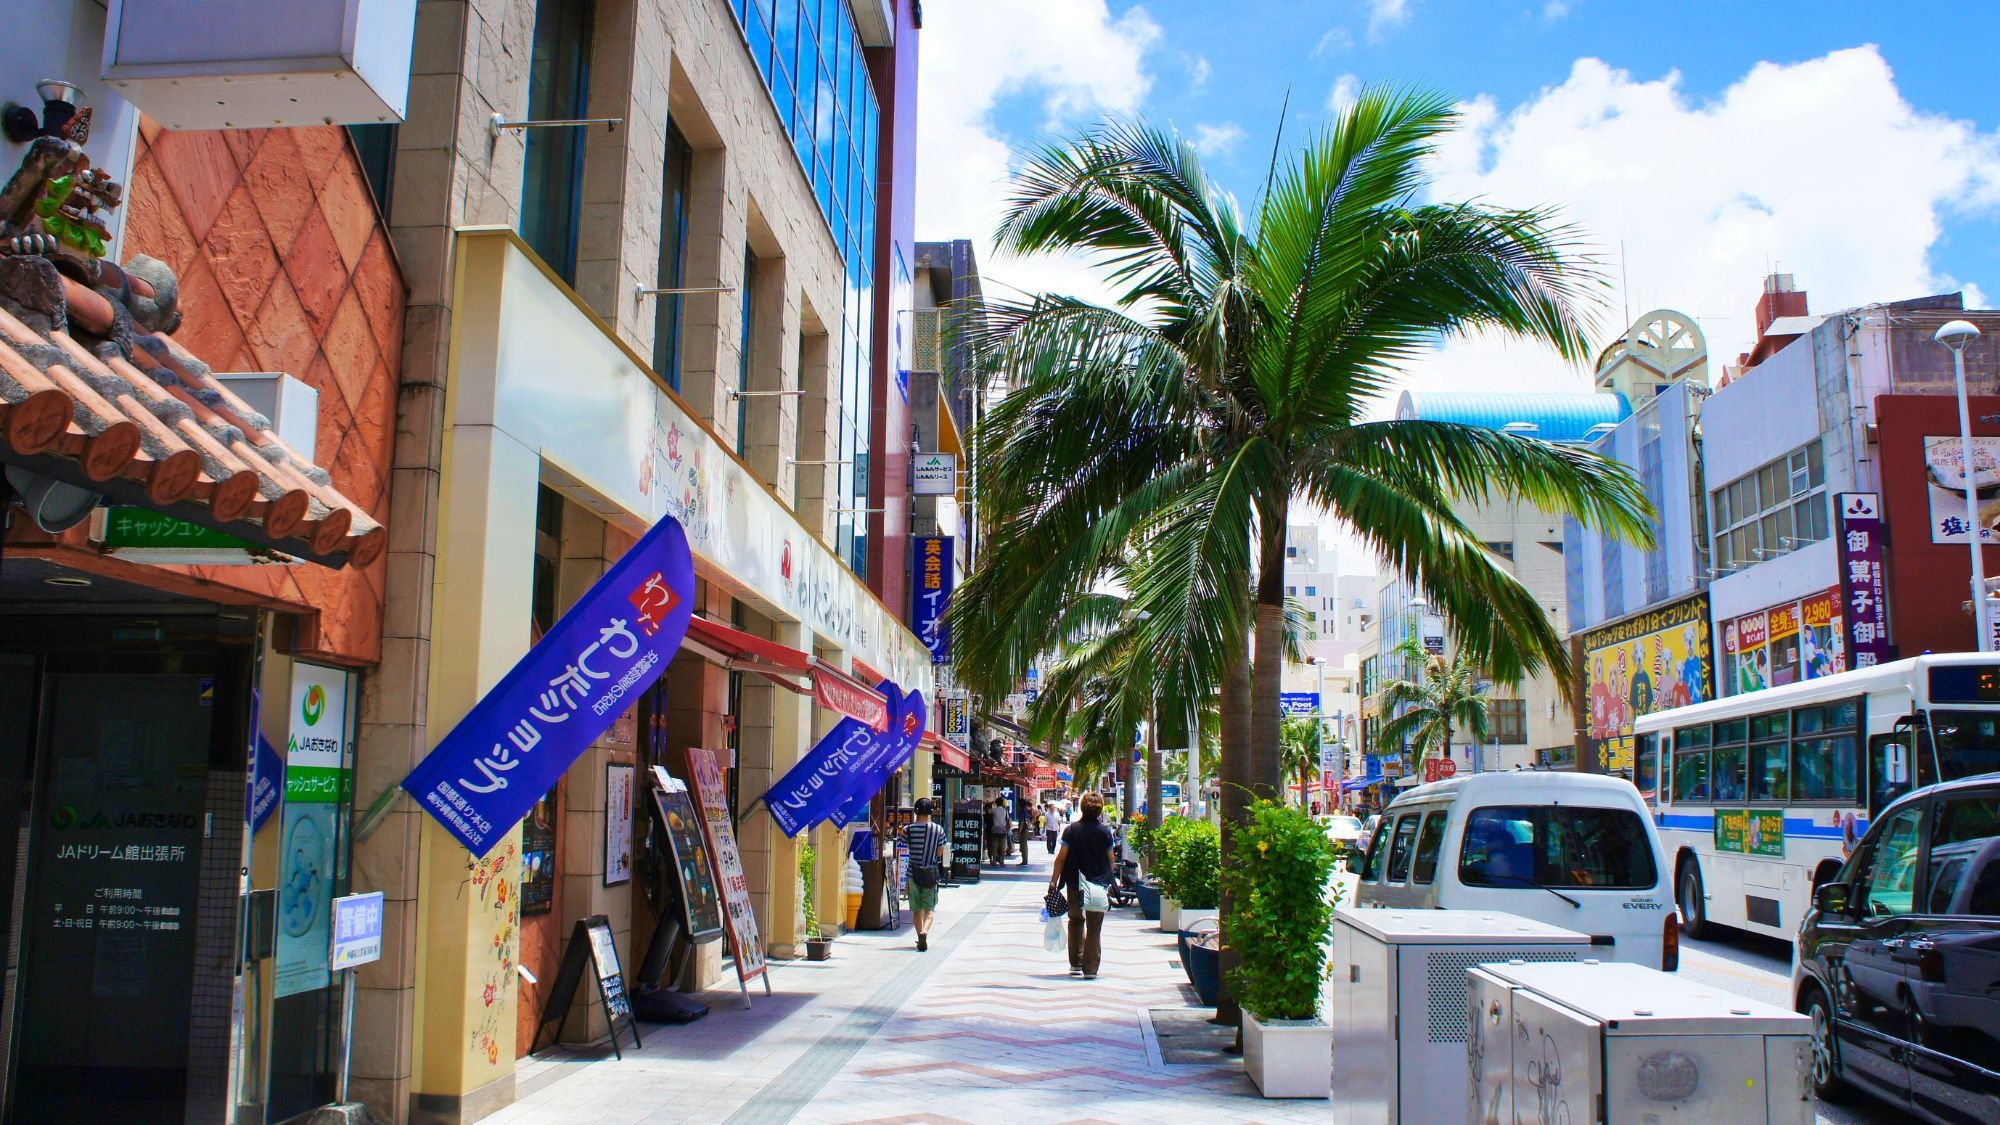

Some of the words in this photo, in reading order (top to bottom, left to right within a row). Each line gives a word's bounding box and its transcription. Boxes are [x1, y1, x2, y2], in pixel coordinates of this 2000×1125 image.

[925, 539, 942, 589] 英会話
[1846, 530, 1878, 669] 御菓子御殿
[922, 589, 942, 651] イーオン
[1771, 610, 1787, 633] 全身
[1804, 600, 1831, 623] 2,960
[458, 616, 640, 794] わしたショップ
[299, 737, 338, 753] JAおきなわ
[783, 726, 872, 808] わしたショップ
[435, 780, 493, 835] 国際通り本店
[114, 812, 196, 829] JAおきなわ
[954, 820, 979, 828] SILVER
[57, 845, 186, 862] JAドリーム館出張所
[94, 888, 142, 900] ご利用時間
